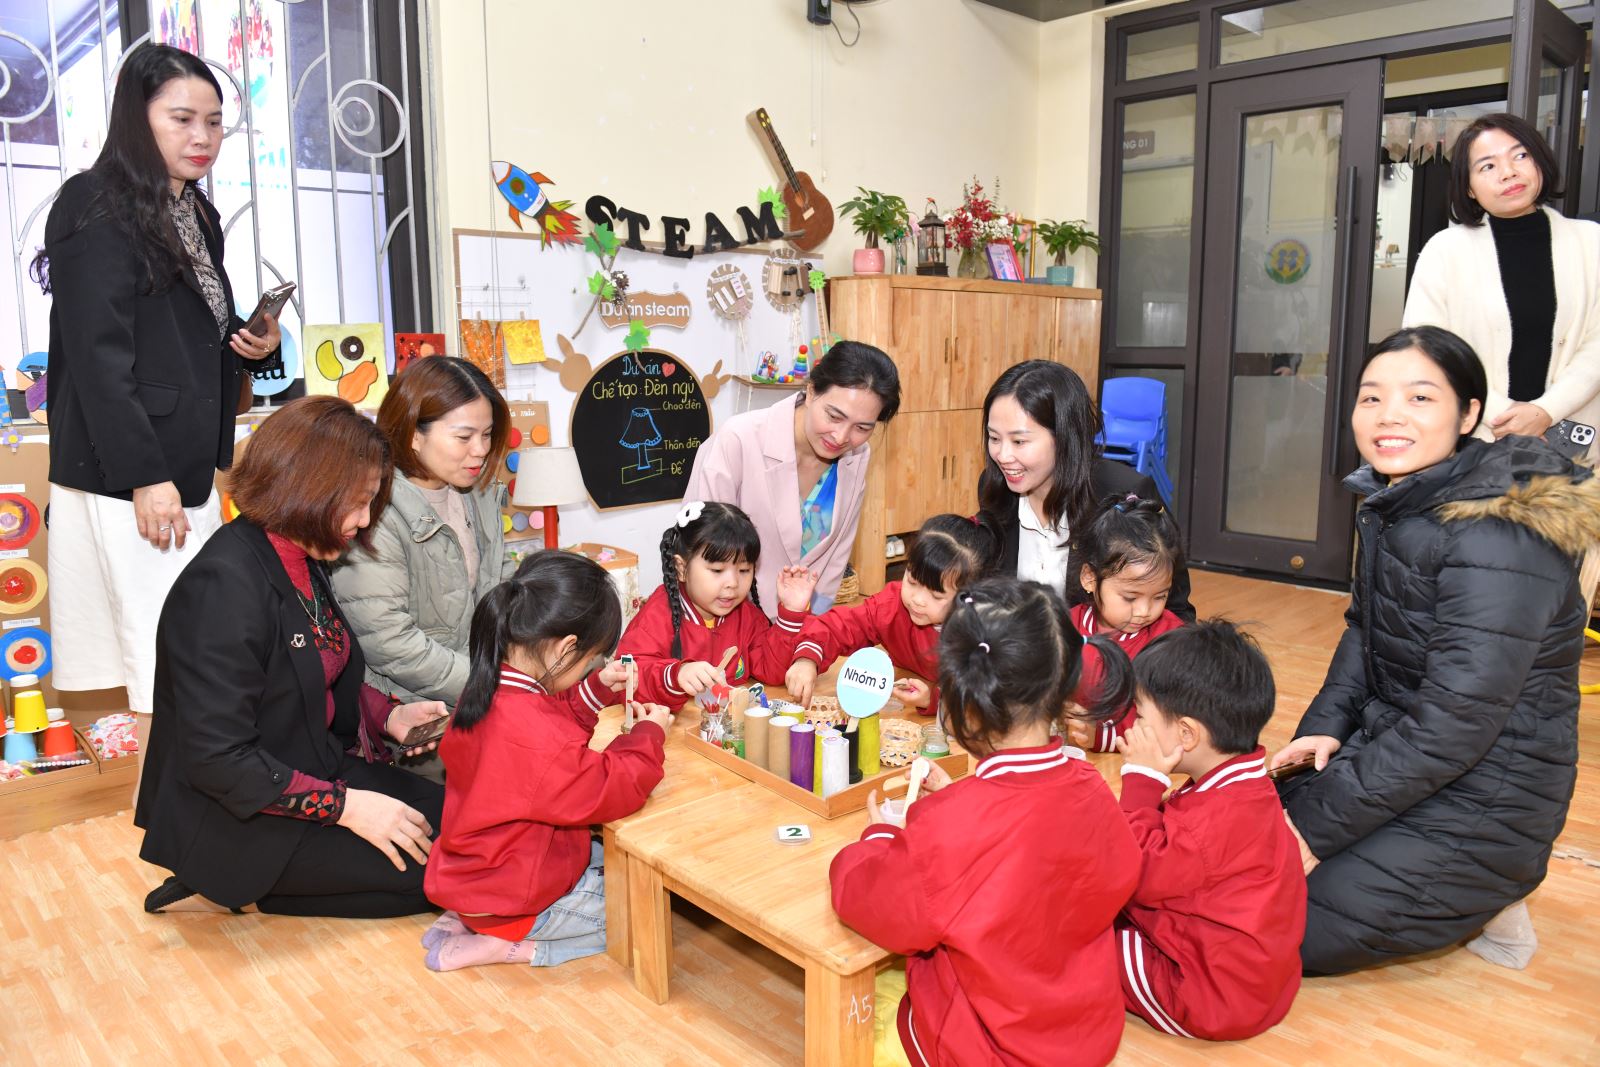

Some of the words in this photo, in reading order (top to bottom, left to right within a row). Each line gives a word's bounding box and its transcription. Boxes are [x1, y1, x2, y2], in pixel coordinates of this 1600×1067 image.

[585, 195, 785, 259] STEAM
[645, 302, 690, 317] steam
[644, 359, 661, 375] án
[592, 378, 619, 400] Chế
[644, 378, 668, 396] Đèn
[672, 376, 695, 403] ngủ
[664, 439, 685, 450] Thân
[671, 458, 686, 475] Đế
[844, 667, 877, 688] Nhóm
[878, 677, 888, 690] 3
[785, 827, 803, 837] 2
[847, 993, 873, 1026] A5
